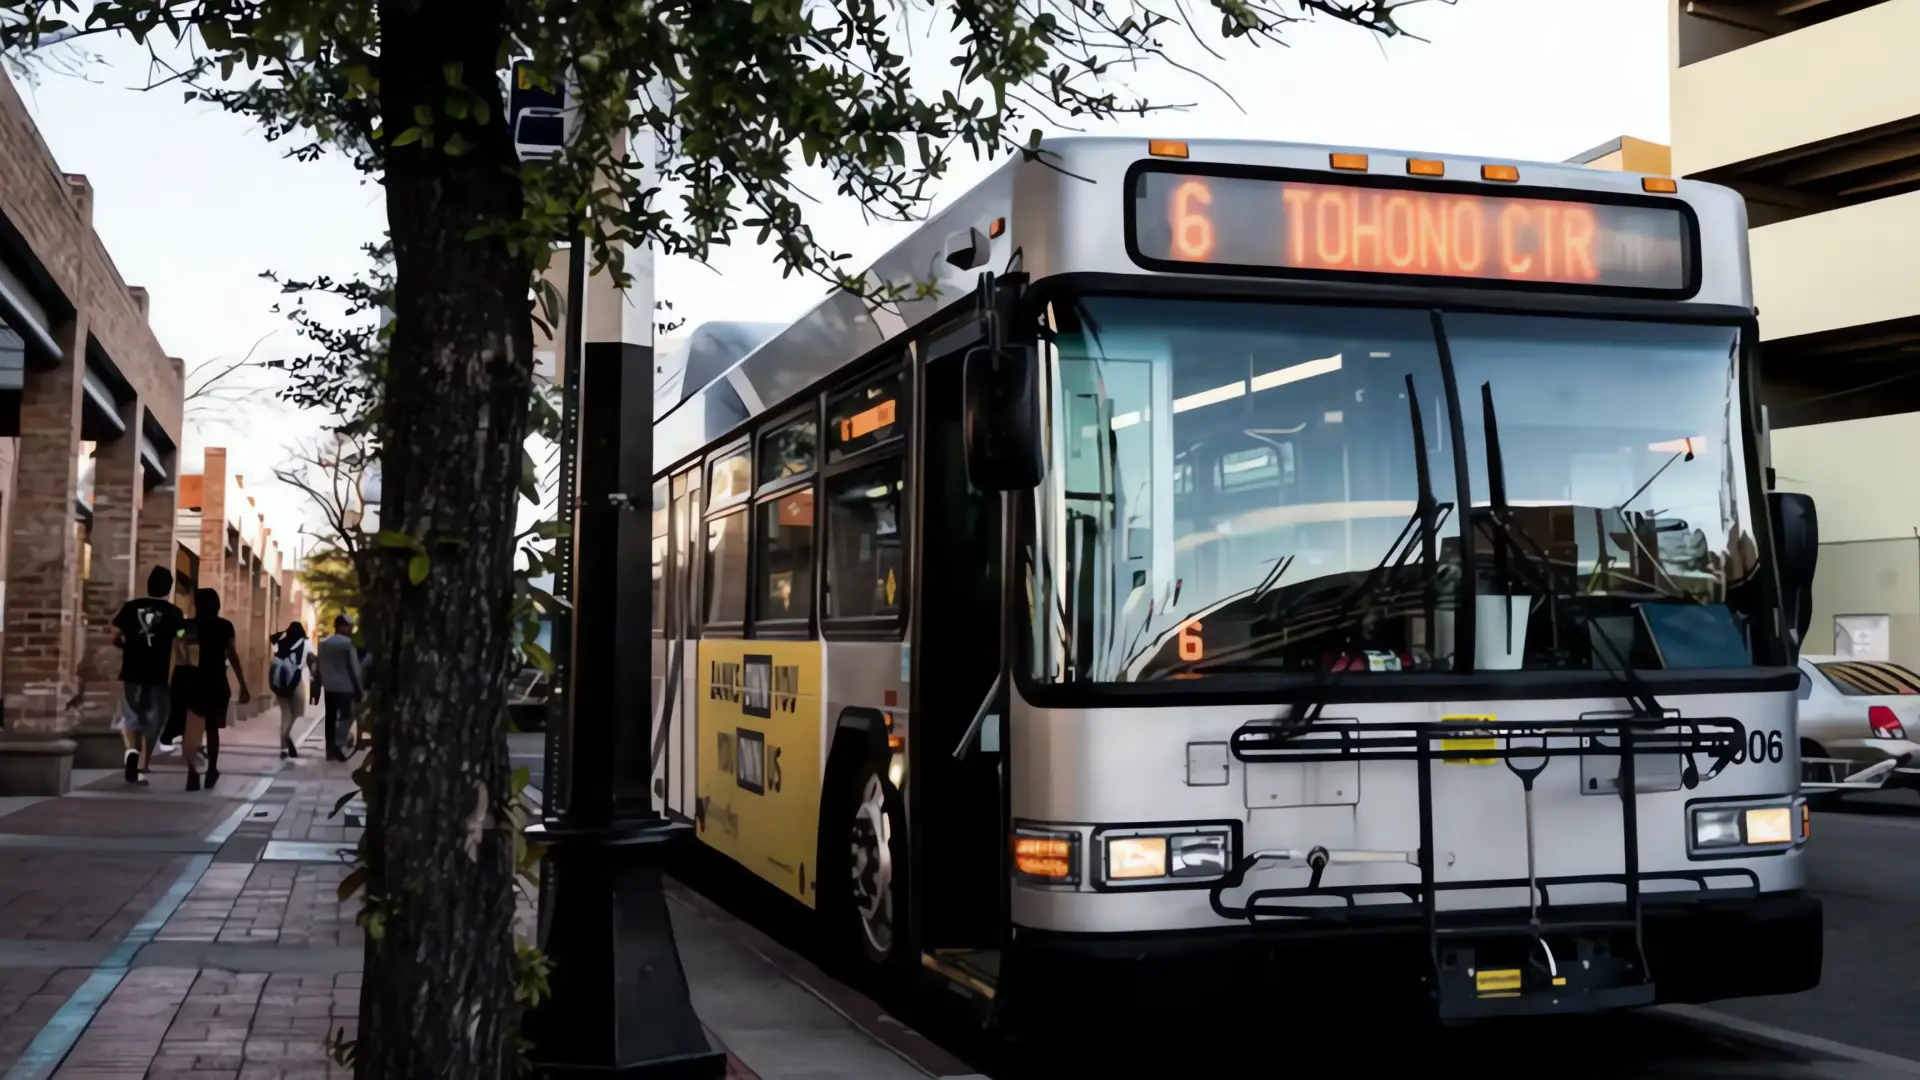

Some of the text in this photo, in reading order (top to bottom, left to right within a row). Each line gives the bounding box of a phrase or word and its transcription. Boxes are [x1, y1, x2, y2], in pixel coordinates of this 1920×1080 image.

[1170, 179, 1598, 284] 6 TOHONO CTR
[1179, 619, 1203, 661] 6
